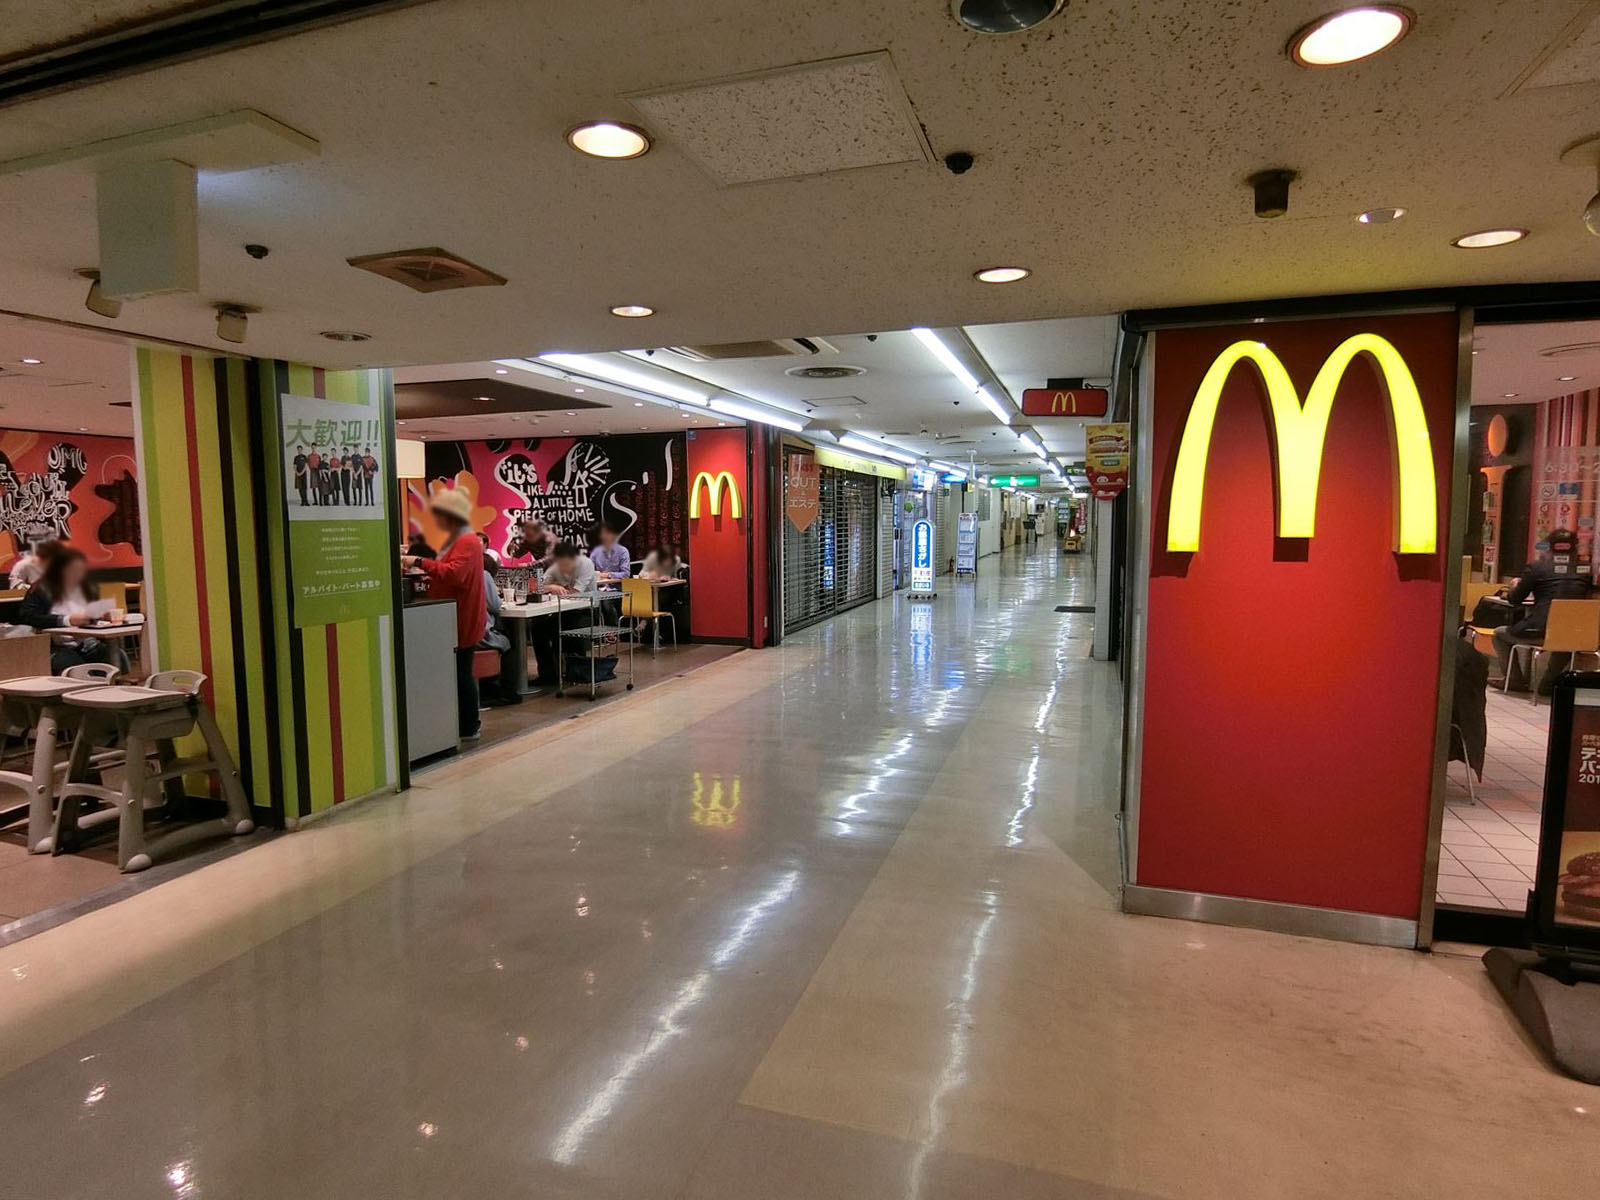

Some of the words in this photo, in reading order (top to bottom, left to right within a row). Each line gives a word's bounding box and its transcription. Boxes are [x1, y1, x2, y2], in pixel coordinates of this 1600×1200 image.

[1167, 333, 1437, 553] M
[520, 484, 544, 496] LIKE
[690, 471, 743, 519] M
[532, 498, 541, 508] A
[542, 497, 574, 508] LITTLE
[558, 508, 595, 522] HOME
[1580, 747, 1600, 760] テ
